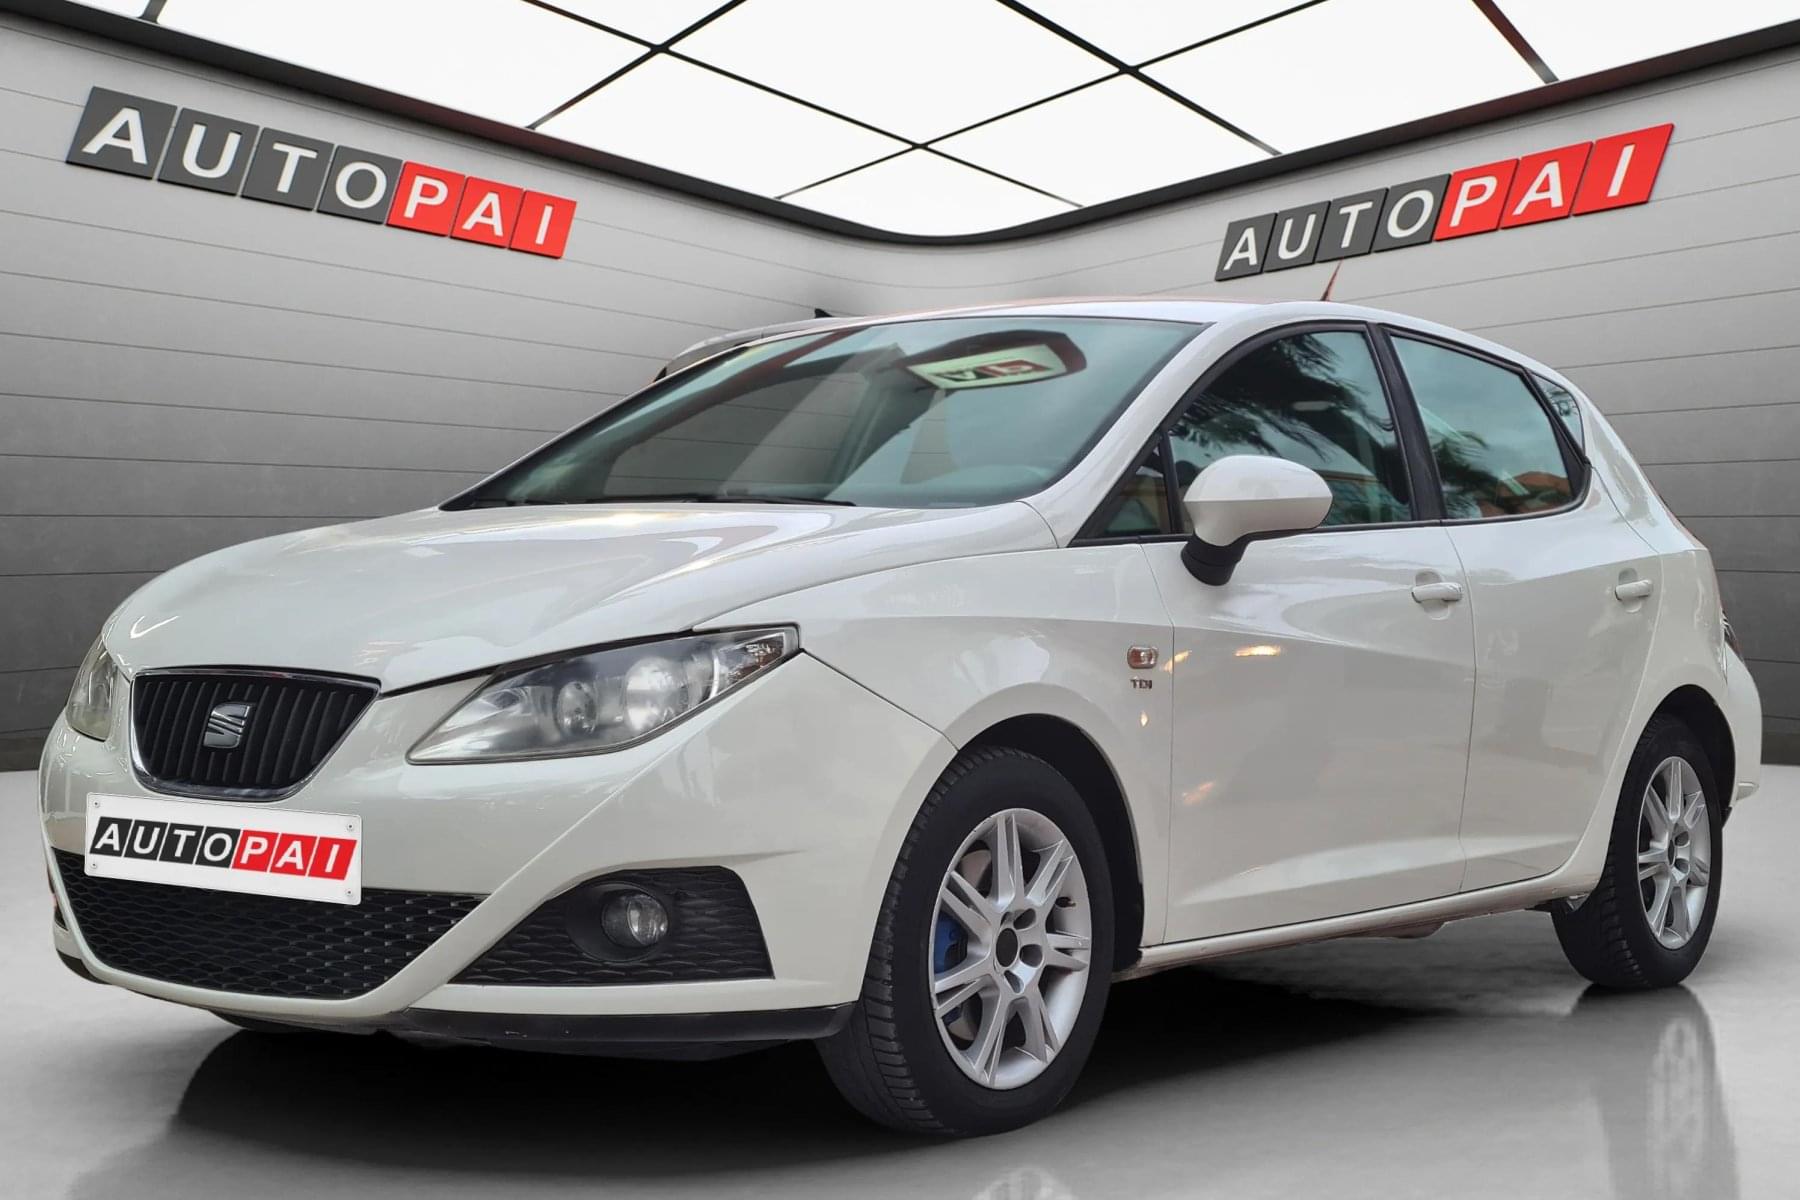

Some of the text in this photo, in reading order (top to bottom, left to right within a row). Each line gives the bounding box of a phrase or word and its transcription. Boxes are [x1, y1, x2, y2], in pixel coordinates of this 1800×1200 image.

[82, 107, 553, 245] AUTOPAI
[1223, 143, 1636, 271] AUTOPAI
[94, 822, 341, 873] AUTOPAI
